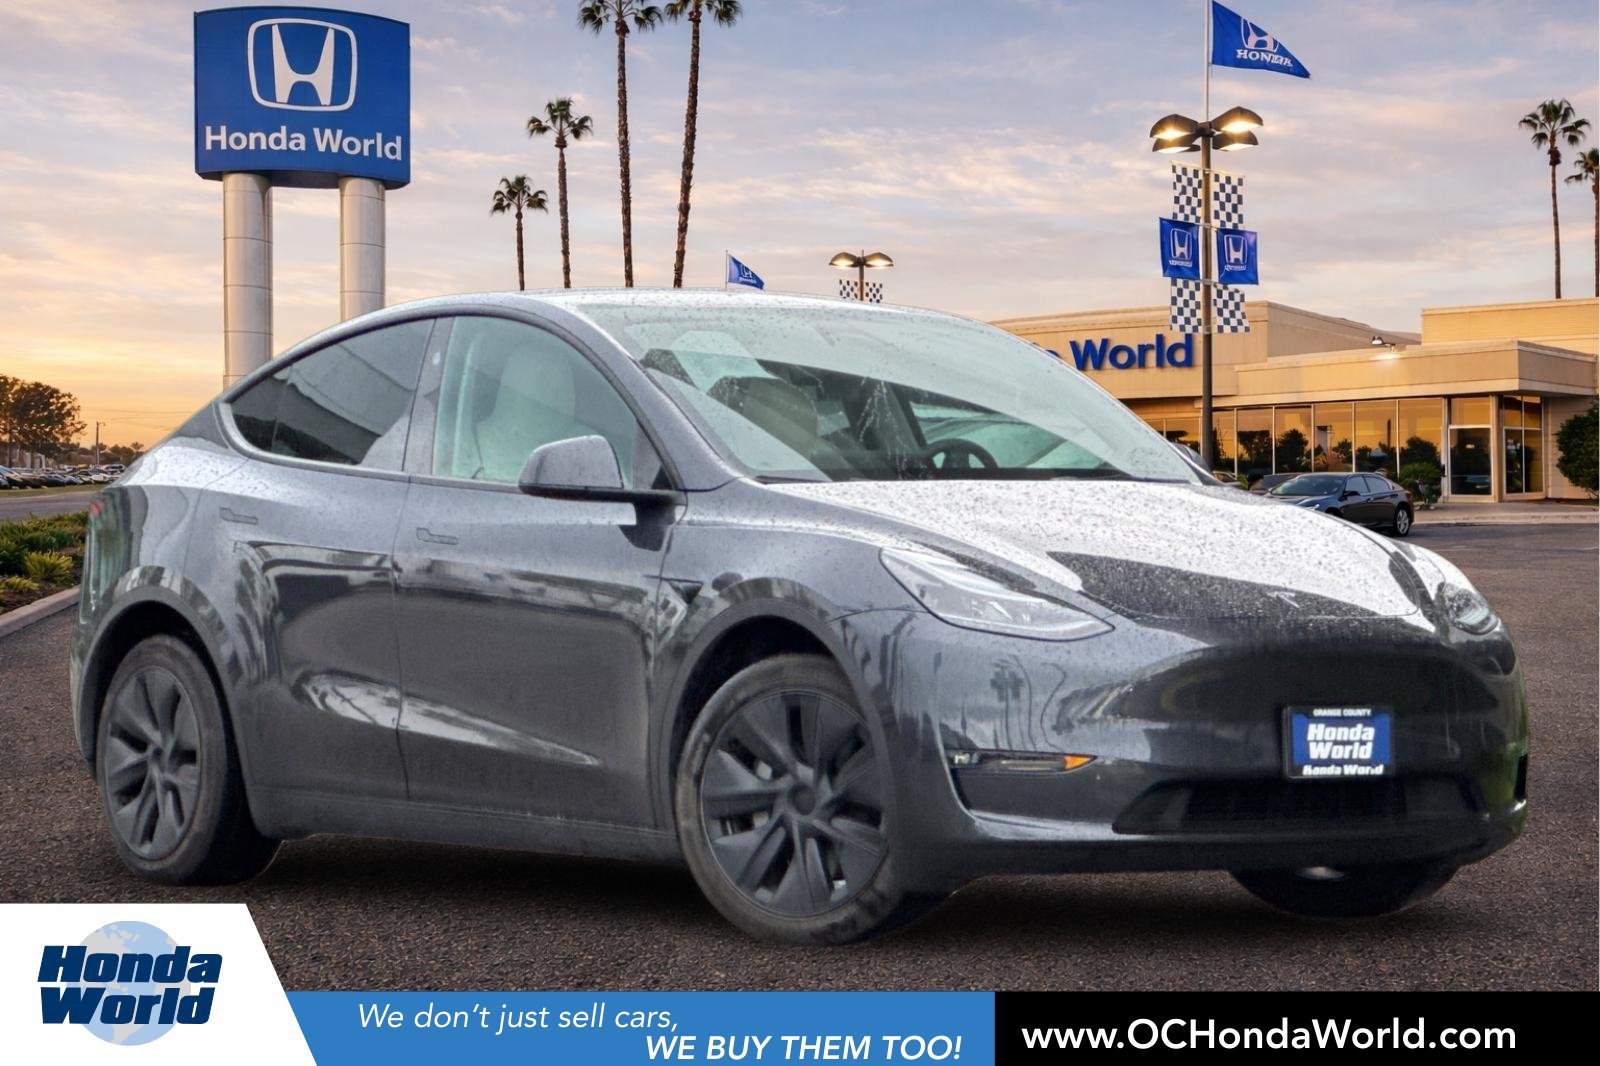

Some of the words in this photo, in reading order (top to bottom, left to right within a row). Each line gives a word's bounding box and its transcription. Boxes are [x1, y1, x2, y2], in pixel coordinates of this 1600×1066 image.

[205, 125, 305, 151] Honda
[313, 127, 402, 161] World
[1069, 333, 1194, 371] World
[1343, 708, 1372, 717] COUNTY
[1307, 723, 1375, 741] Honda
[1309, 741, 1373, 760] World
